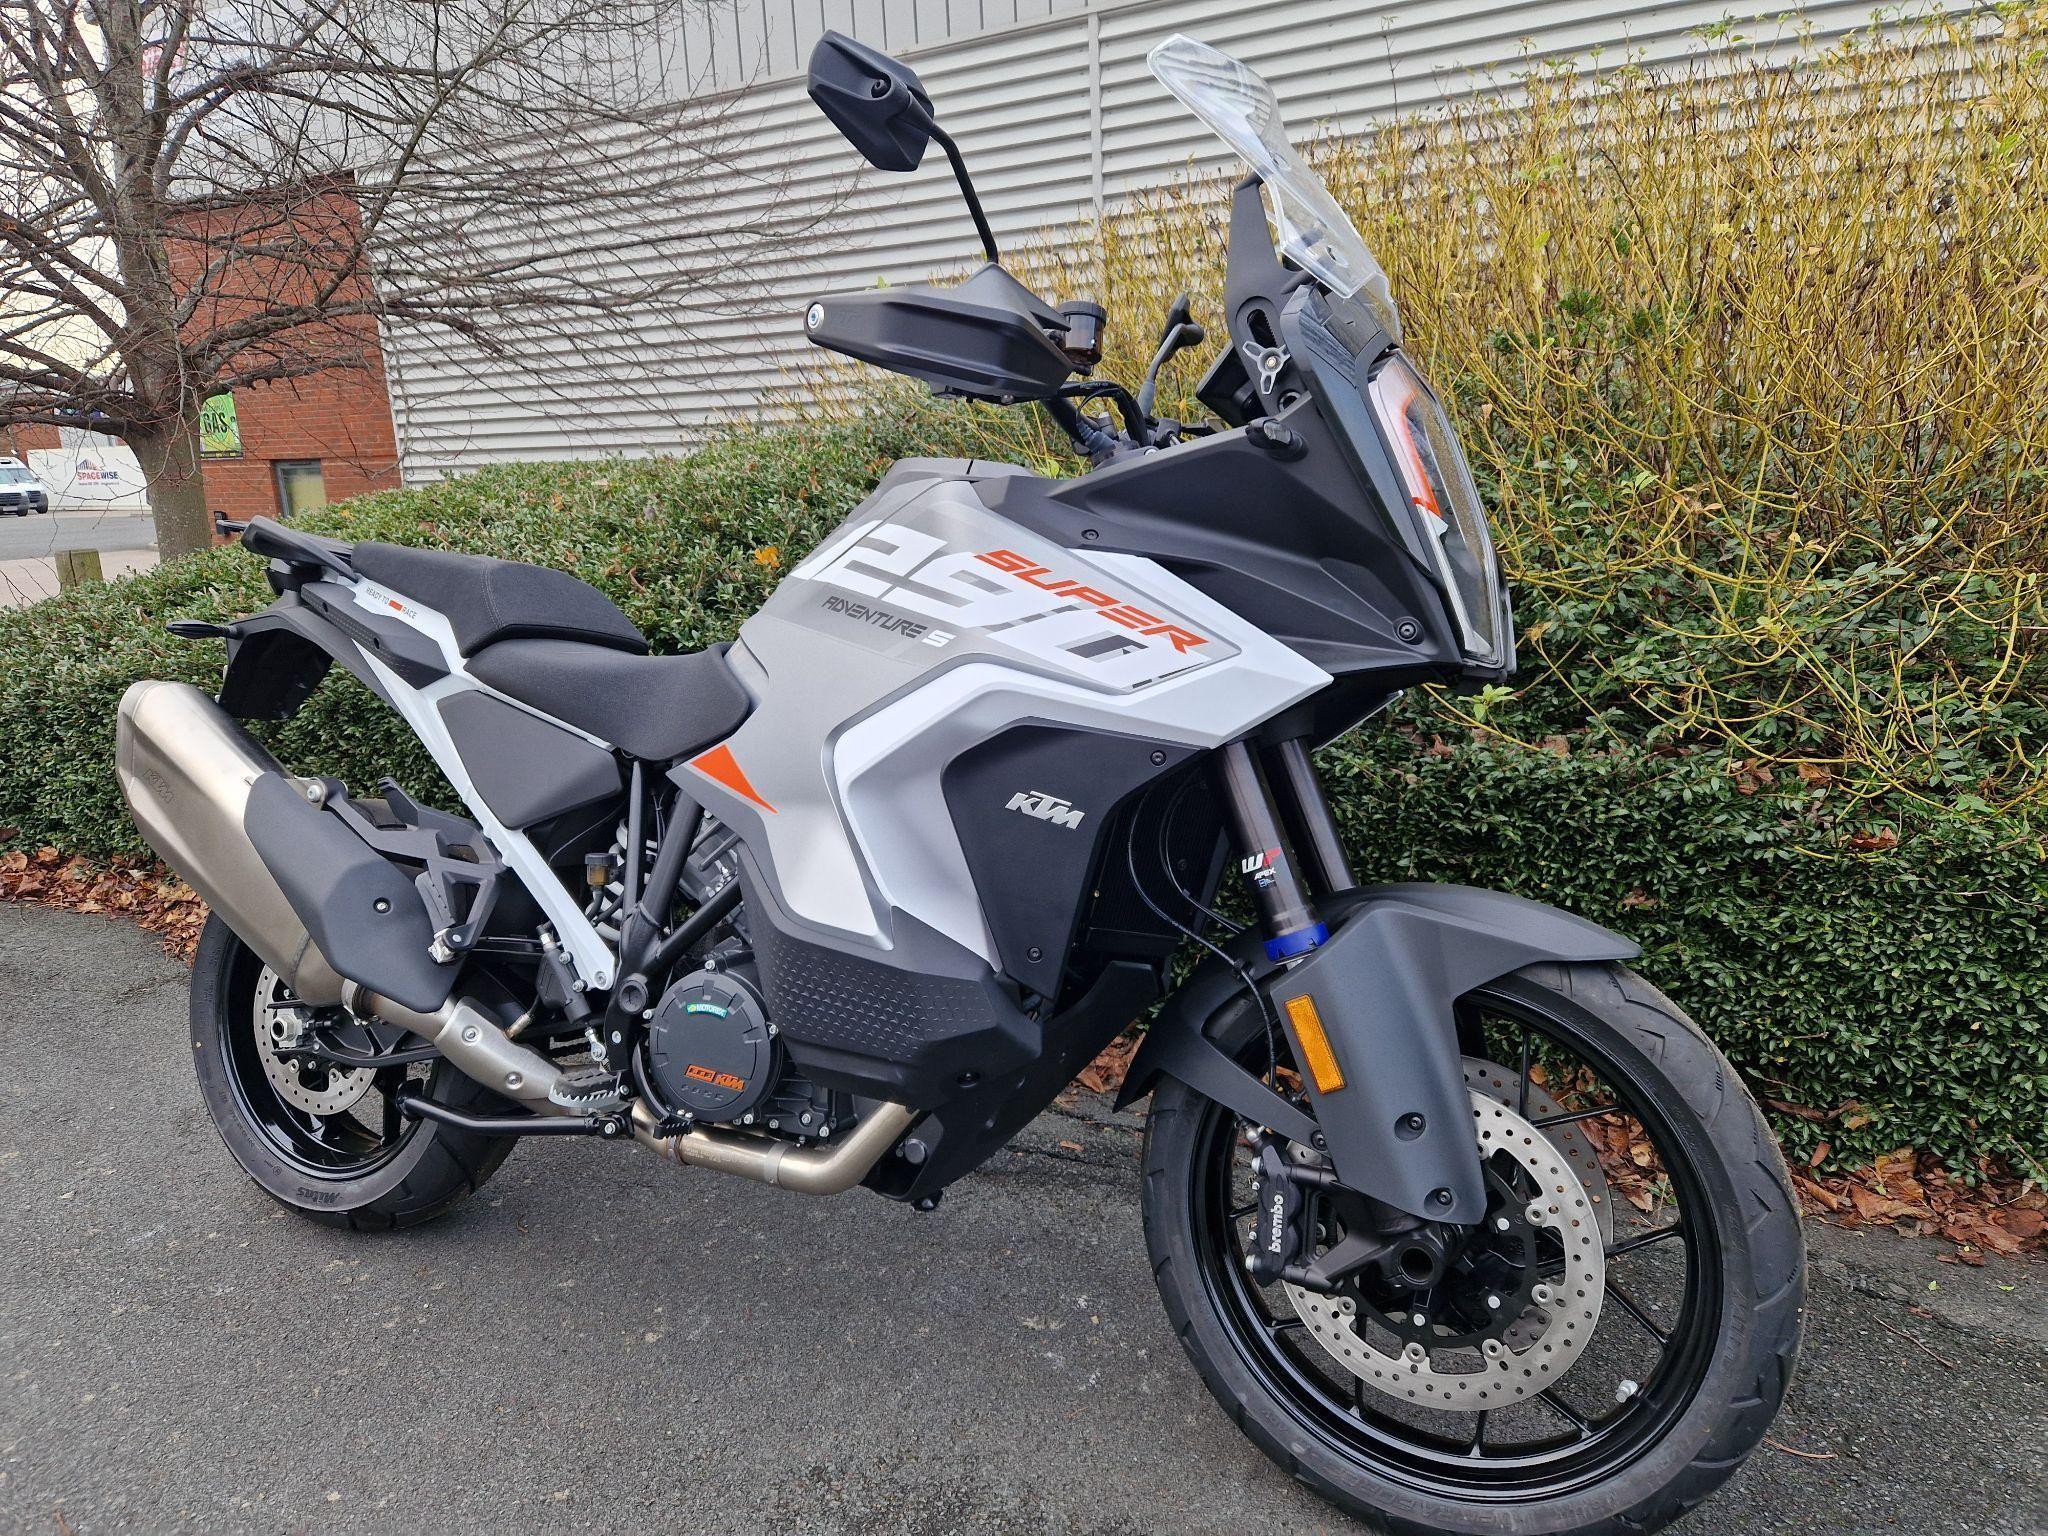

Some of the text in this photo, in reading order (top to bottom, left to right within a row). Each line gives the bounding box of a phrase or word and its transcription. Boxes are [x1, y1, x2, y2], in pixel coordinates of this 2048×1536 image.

[76, 471, 119, 480] SPACEWISE
[366, 587, 382, 600] READY
[402, 606, 417, 620] RACE
[821, 595, 957, 648] ADVENTURE S
[973, 549, 1210, 655] SUPER
[1004, 790, 1086, 831] KTM
[1268, 1194, 1284, 1254] brembo
